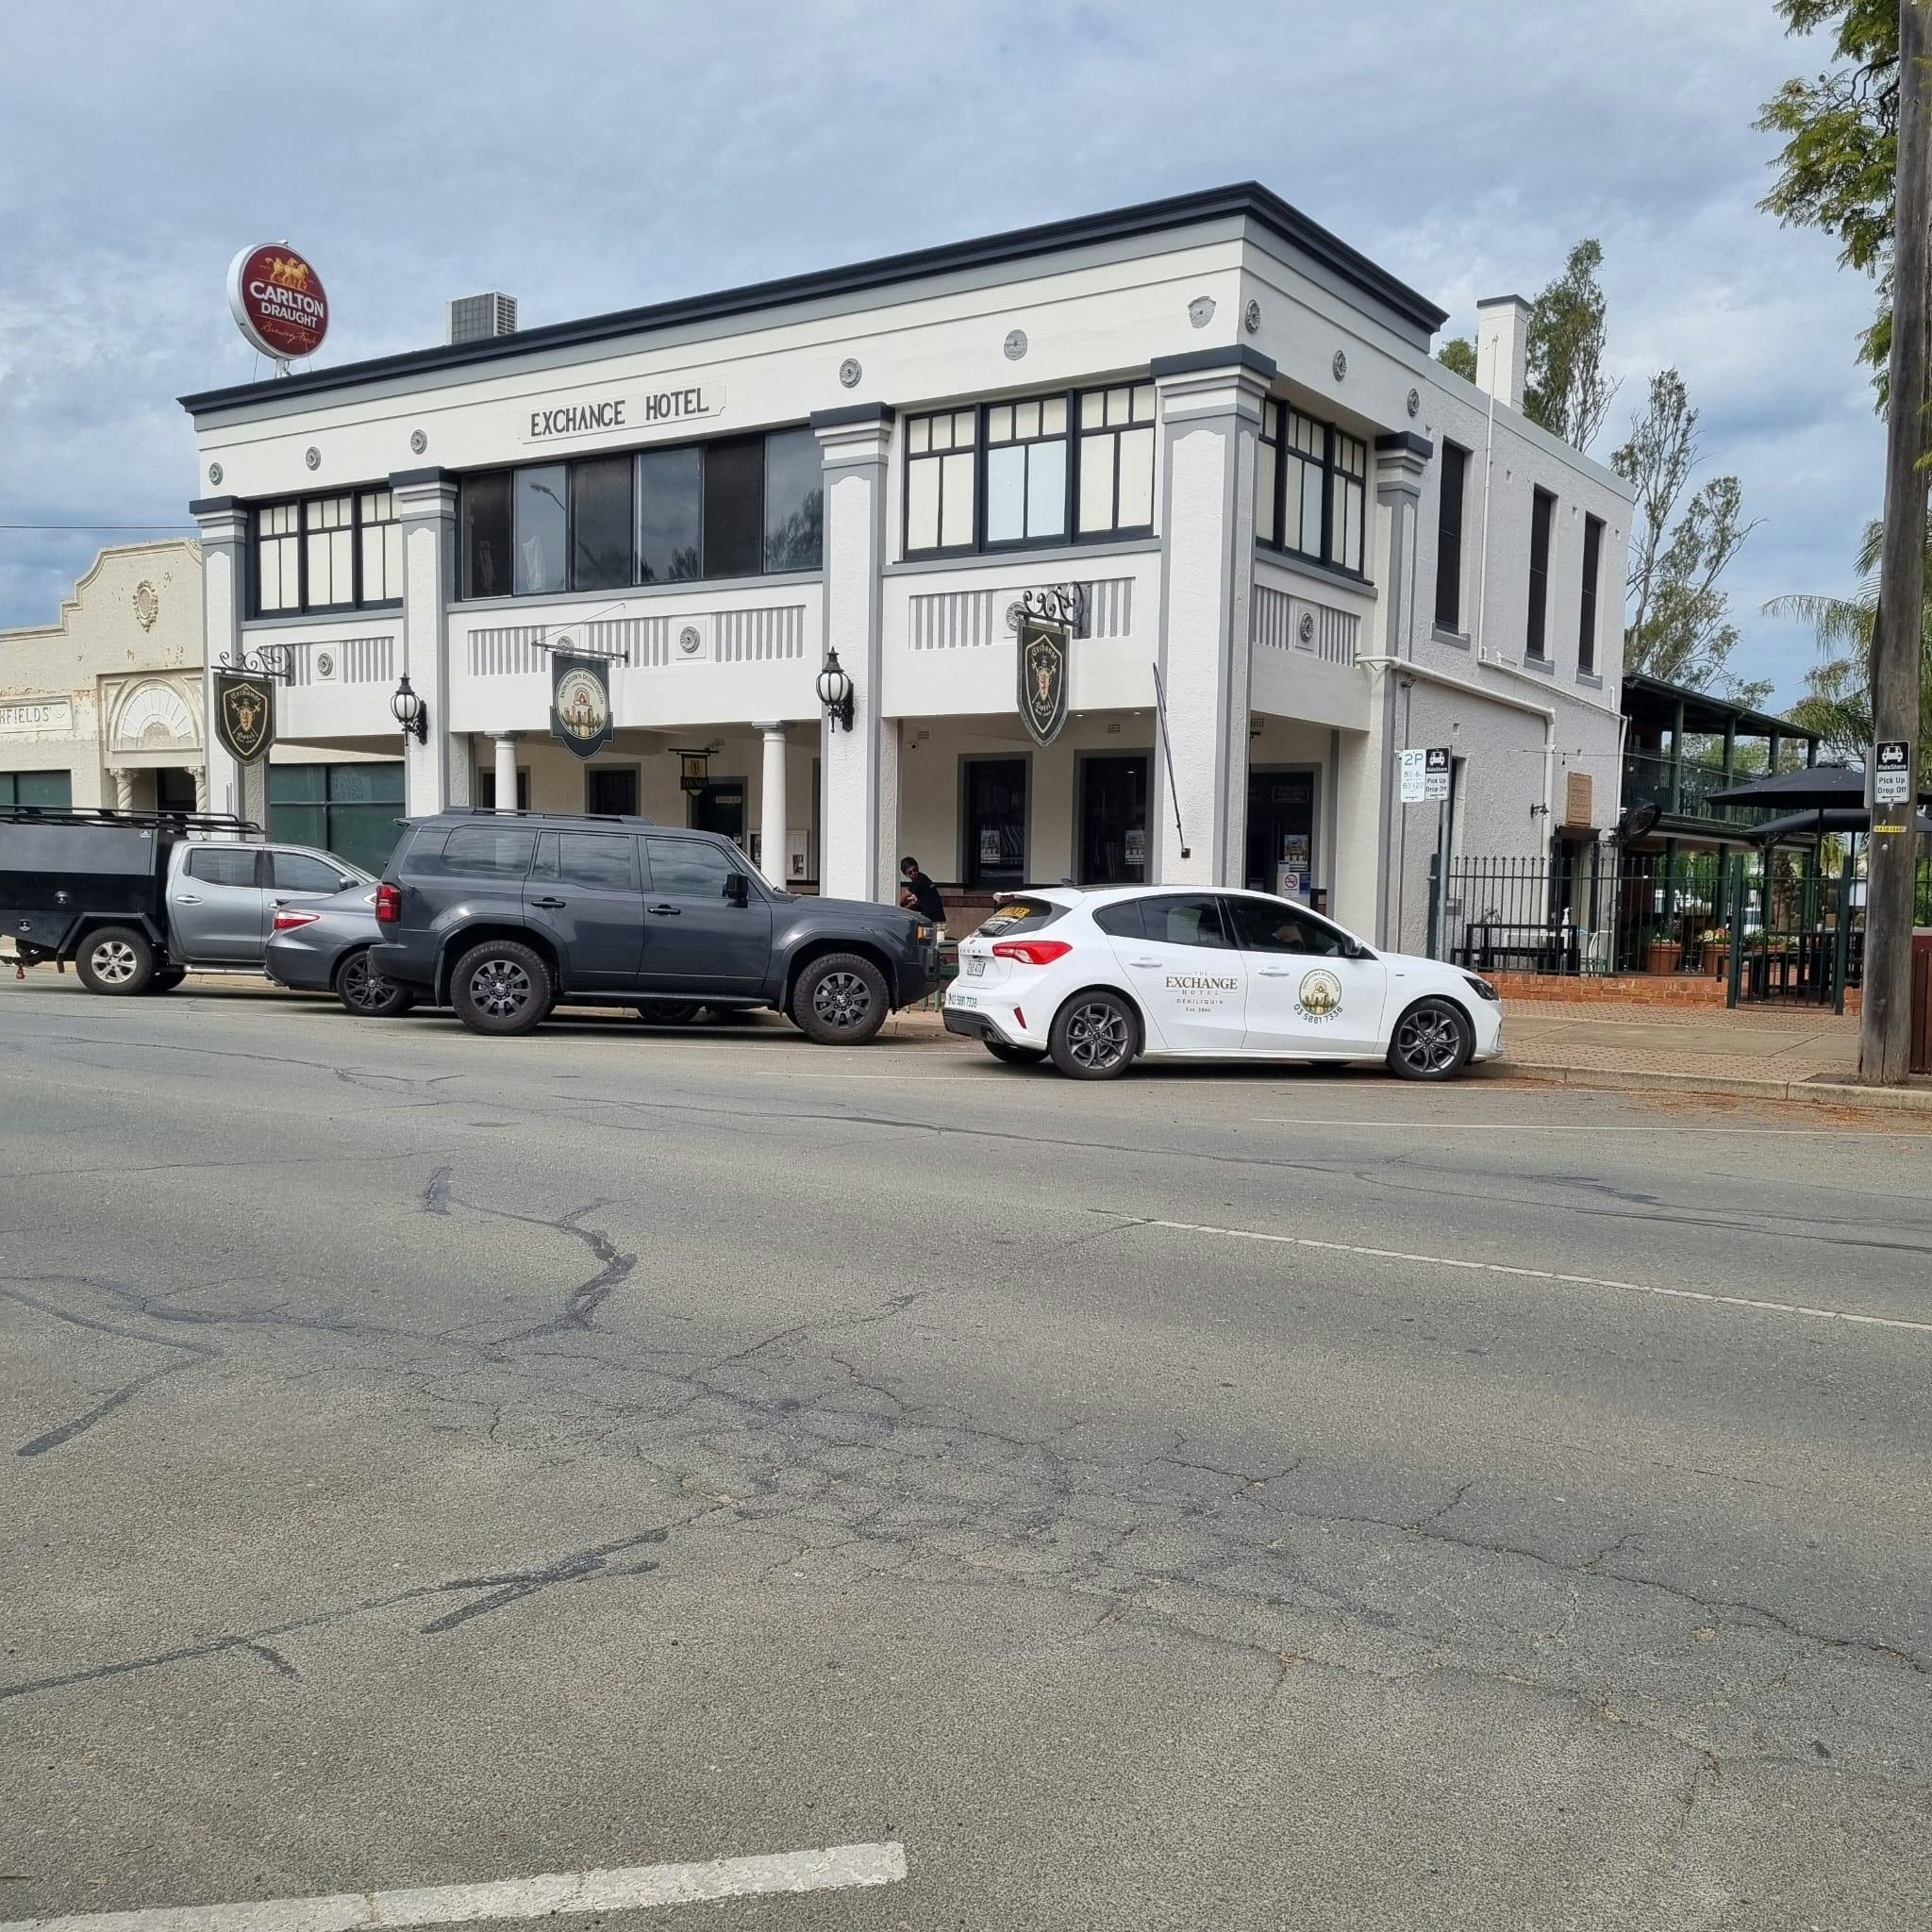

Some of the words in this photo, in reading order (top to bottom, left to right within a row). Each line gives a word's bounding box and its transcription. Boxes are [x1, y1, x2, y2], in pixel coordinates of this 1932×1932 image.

[250, 281, 325, 318] CARLTON
[261, 302, 318, 328] DRAUGHT
[530, 400, 626, 437] EXCHANGE
[645, 388, 709, 421] HOTEL
[1032, 643, 1057, 659] Exchange
[1404, 753, 1423, 765] 2P
[1165, 976, 1239, 990] EXCHANGE
[1293, 1004, 1304, 1015] 03
[1303, 1012, 1323, 1024] 5881
[1324, 1006, 1343, 1024] 7338
